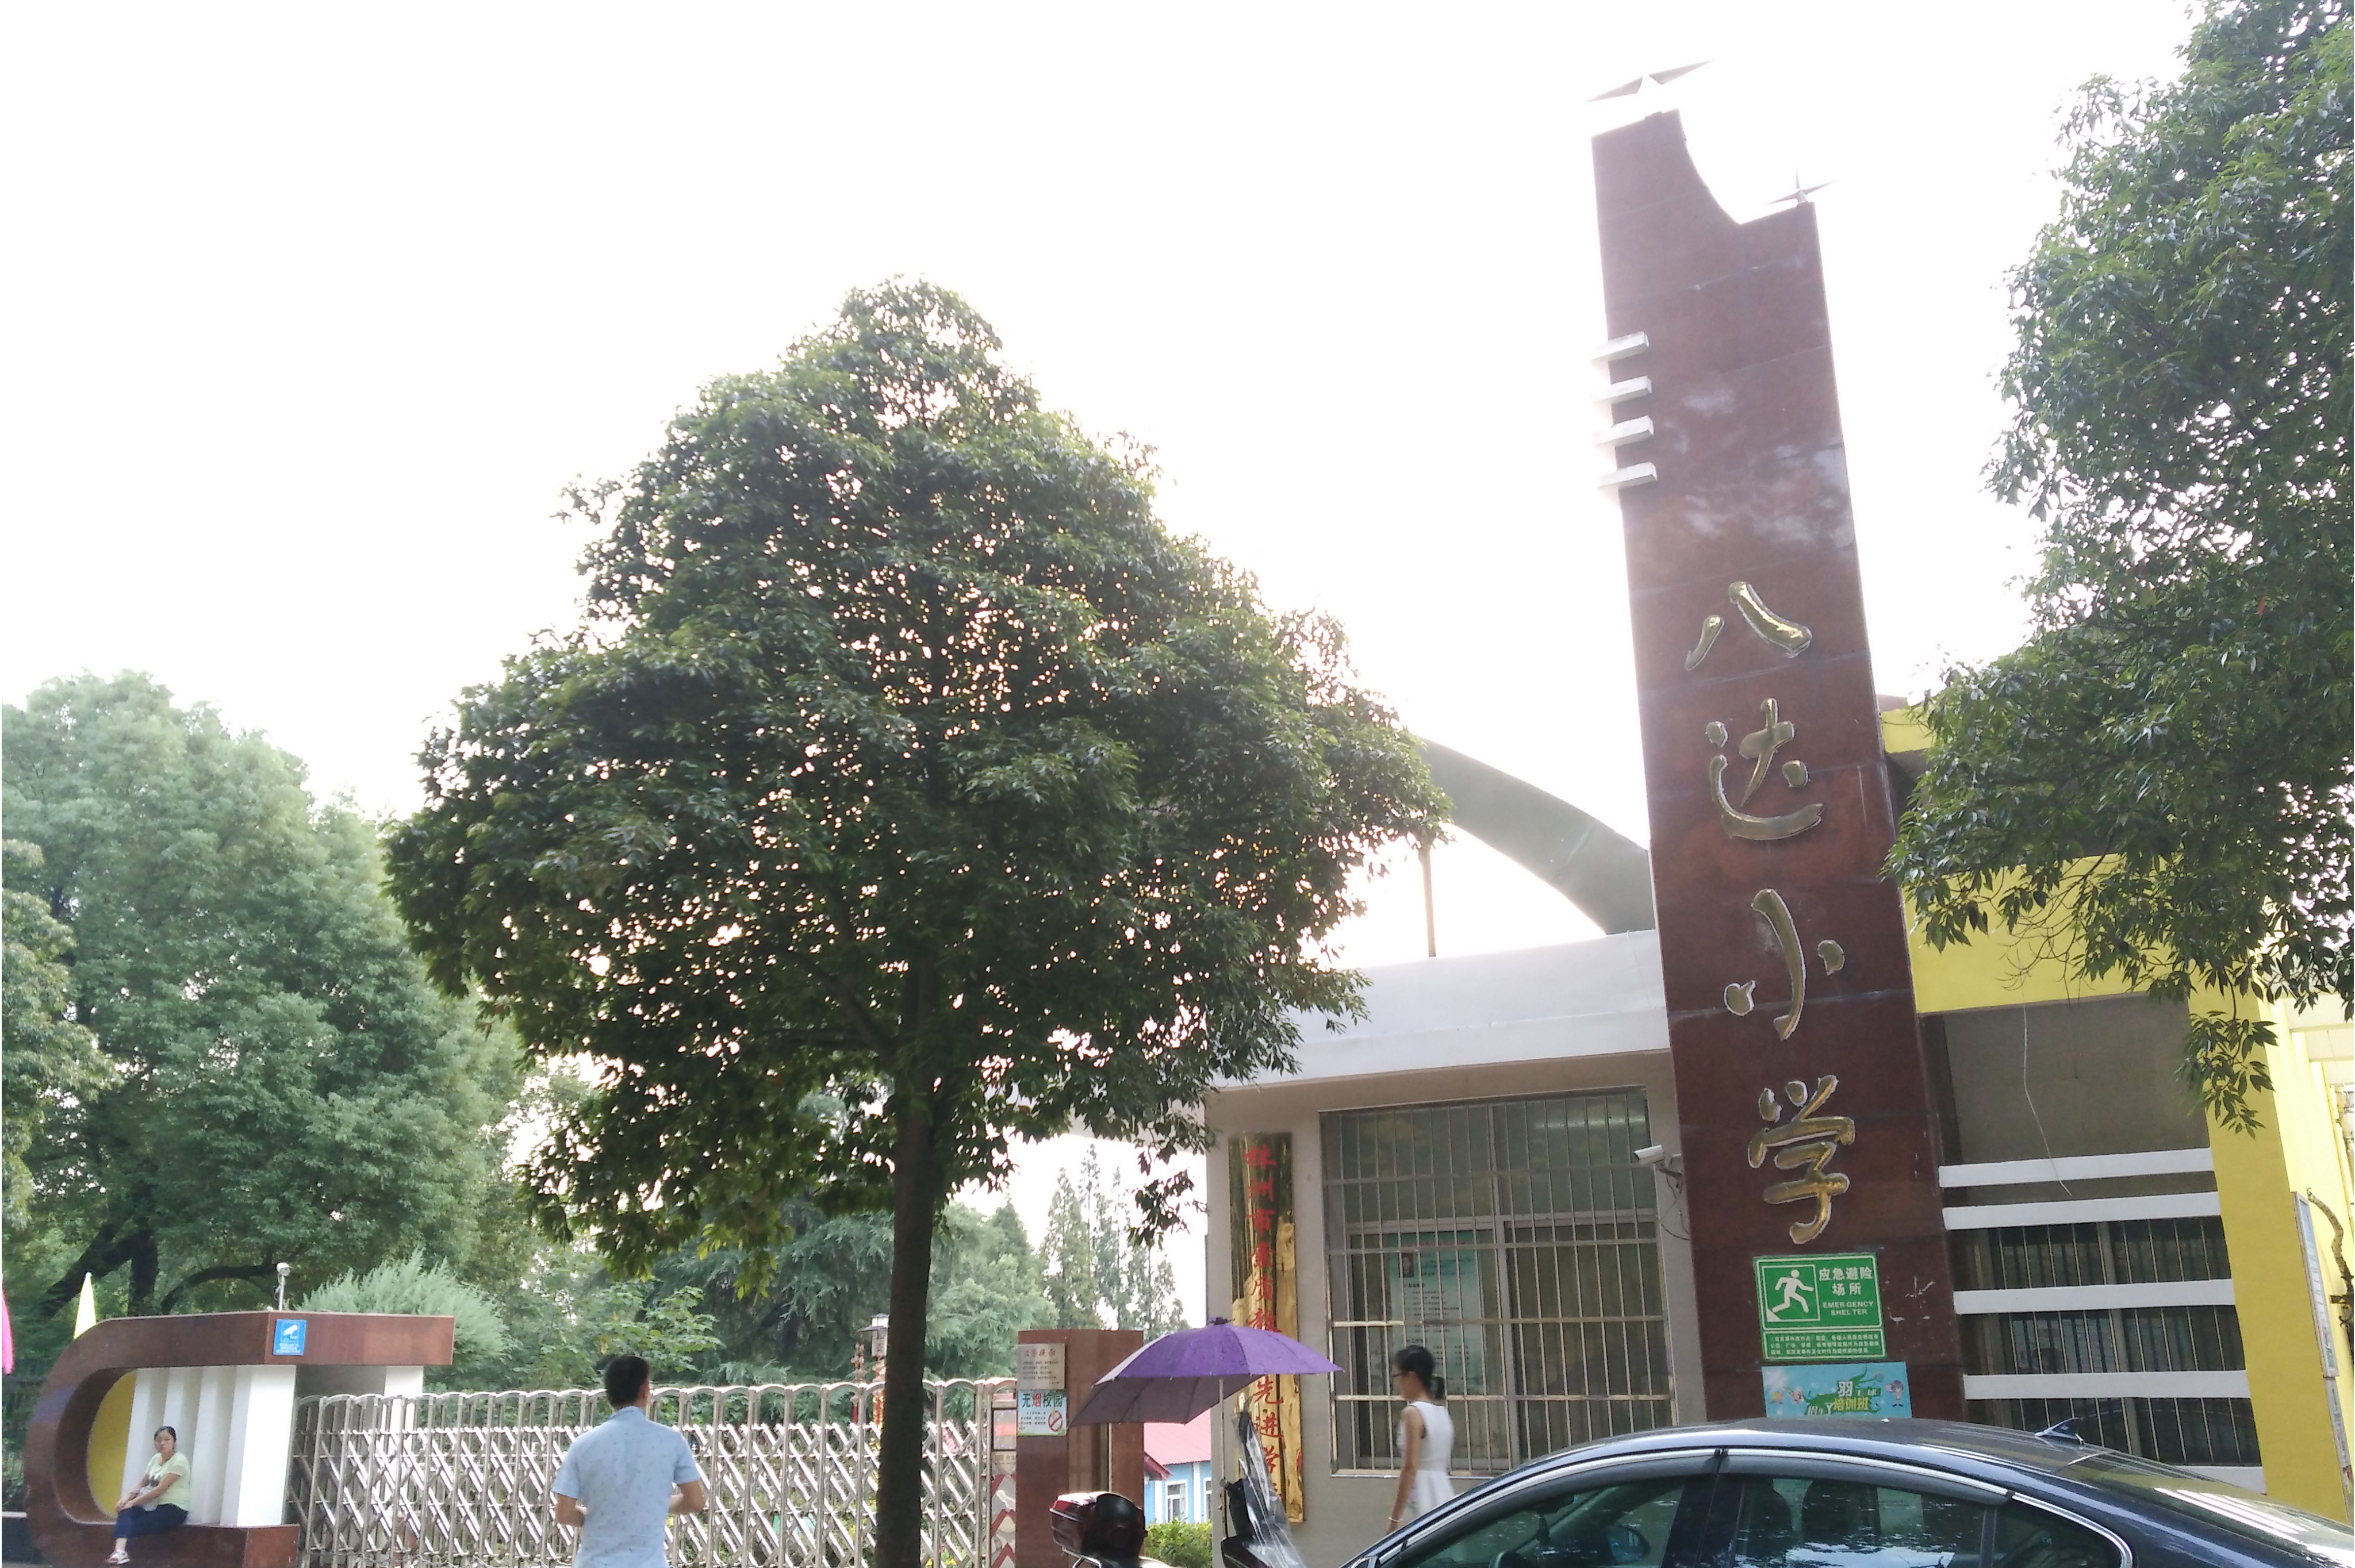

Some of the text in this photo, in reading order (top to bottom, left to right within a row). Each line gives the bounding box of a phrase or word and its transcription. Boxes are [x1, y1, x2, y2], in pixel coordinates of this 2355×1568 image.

[1684, 581, 1856, 1244] 八达小学
[1819, 1266, 1873, 1281] 应急避险
[1832, 1282, 1862, 1296] 场所
[1022, 1393, 1063, 1408] 无烟校园
[1833, 1397, 1869, 1411] 培训班
